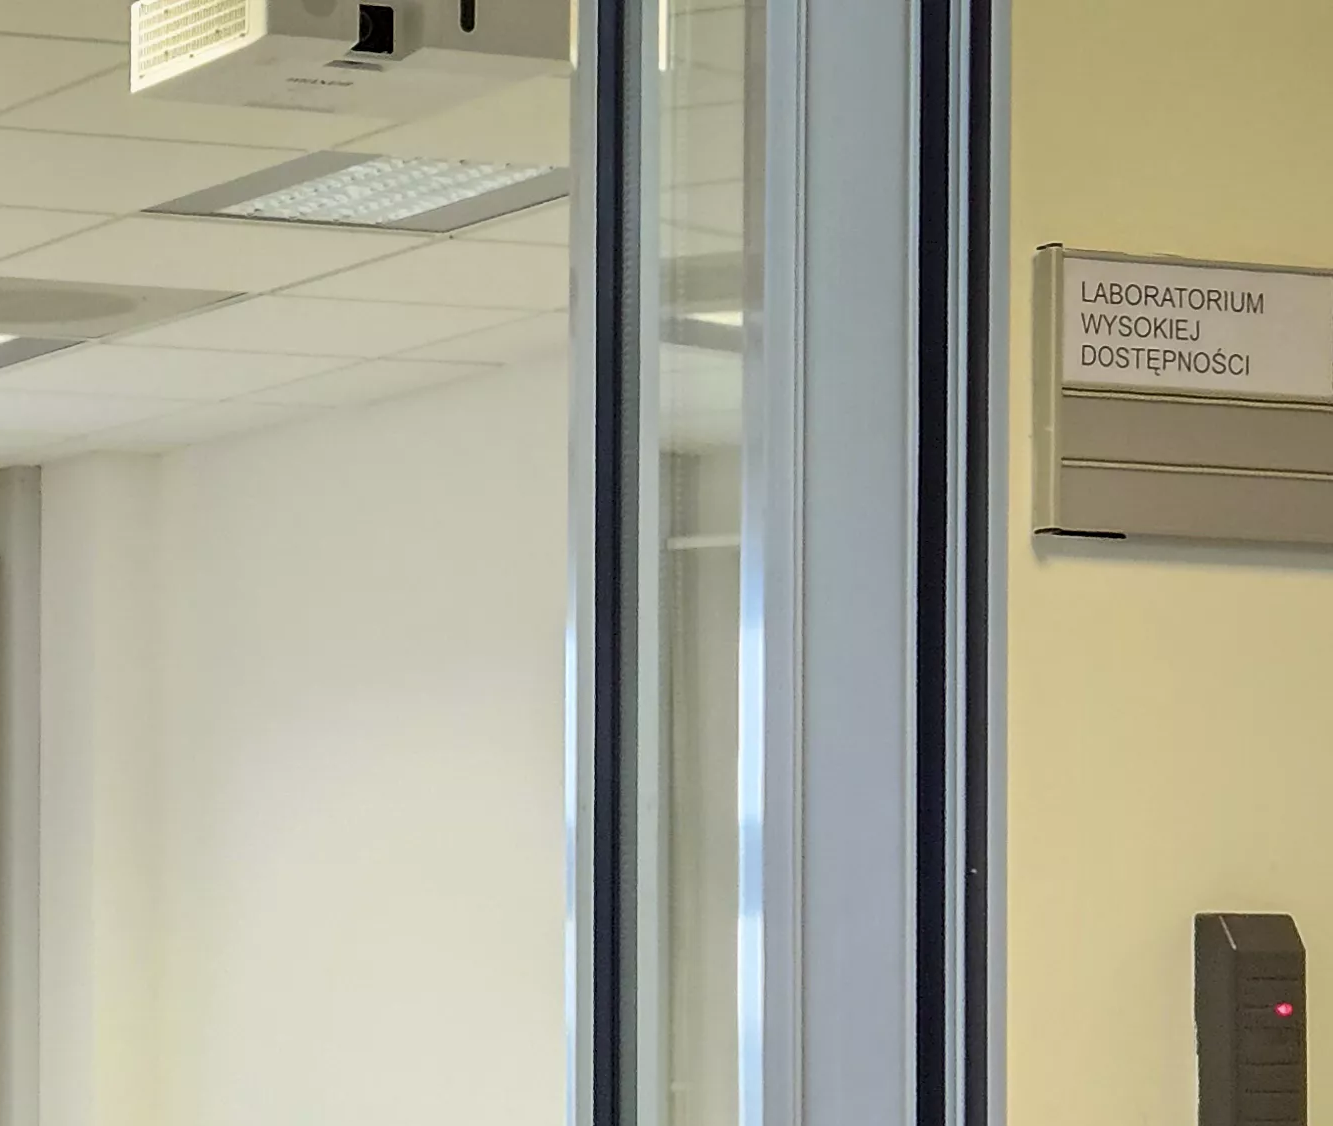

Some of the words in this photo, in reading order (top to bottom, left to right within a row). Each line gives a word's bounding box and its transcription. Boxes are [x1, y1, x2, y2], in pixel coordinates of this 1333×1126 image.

[1081, 281, 1264, 314] LABORATORIUM
[1081, 312, 1200, 341] WYSOKIEJ
[1081, 345, 1249, 376] DOSTĘPNOŚCI
